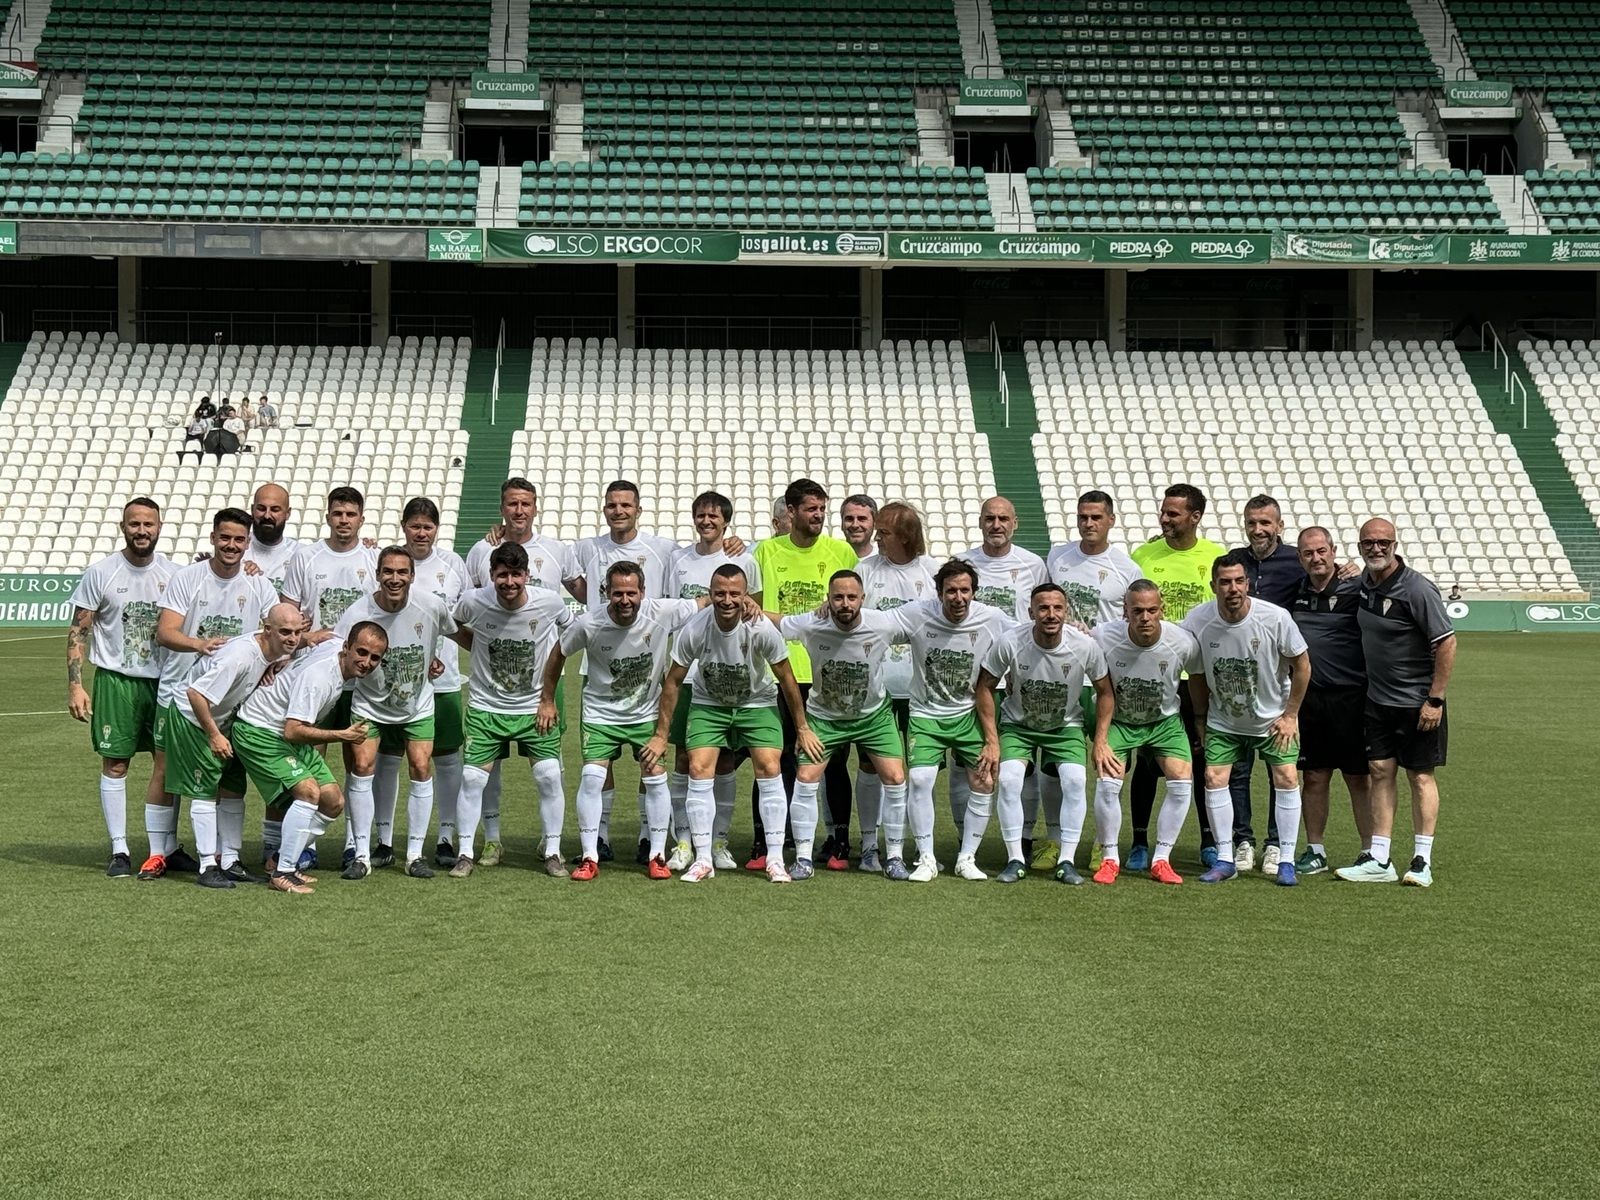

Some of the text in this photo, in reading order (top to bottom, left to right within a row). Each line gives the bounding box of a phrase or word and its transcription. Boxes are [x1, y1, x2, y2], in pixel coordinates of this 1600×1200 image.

[476, 80, 535, 93] Cruzcampo
[965, 86, 1022, 99] Cruzcampo
[1450, 88, 1508, 101] Cruzcampo
[449, 244, 482, 252] RAFAEL
[557, 236, 703, 254] LSC ERGOCOR
[900, 238, 982, 256] Cruzcampo
[999, 238, 1080, 256] Cruzcampo
[440, 252, 472, 260] MOTOR
